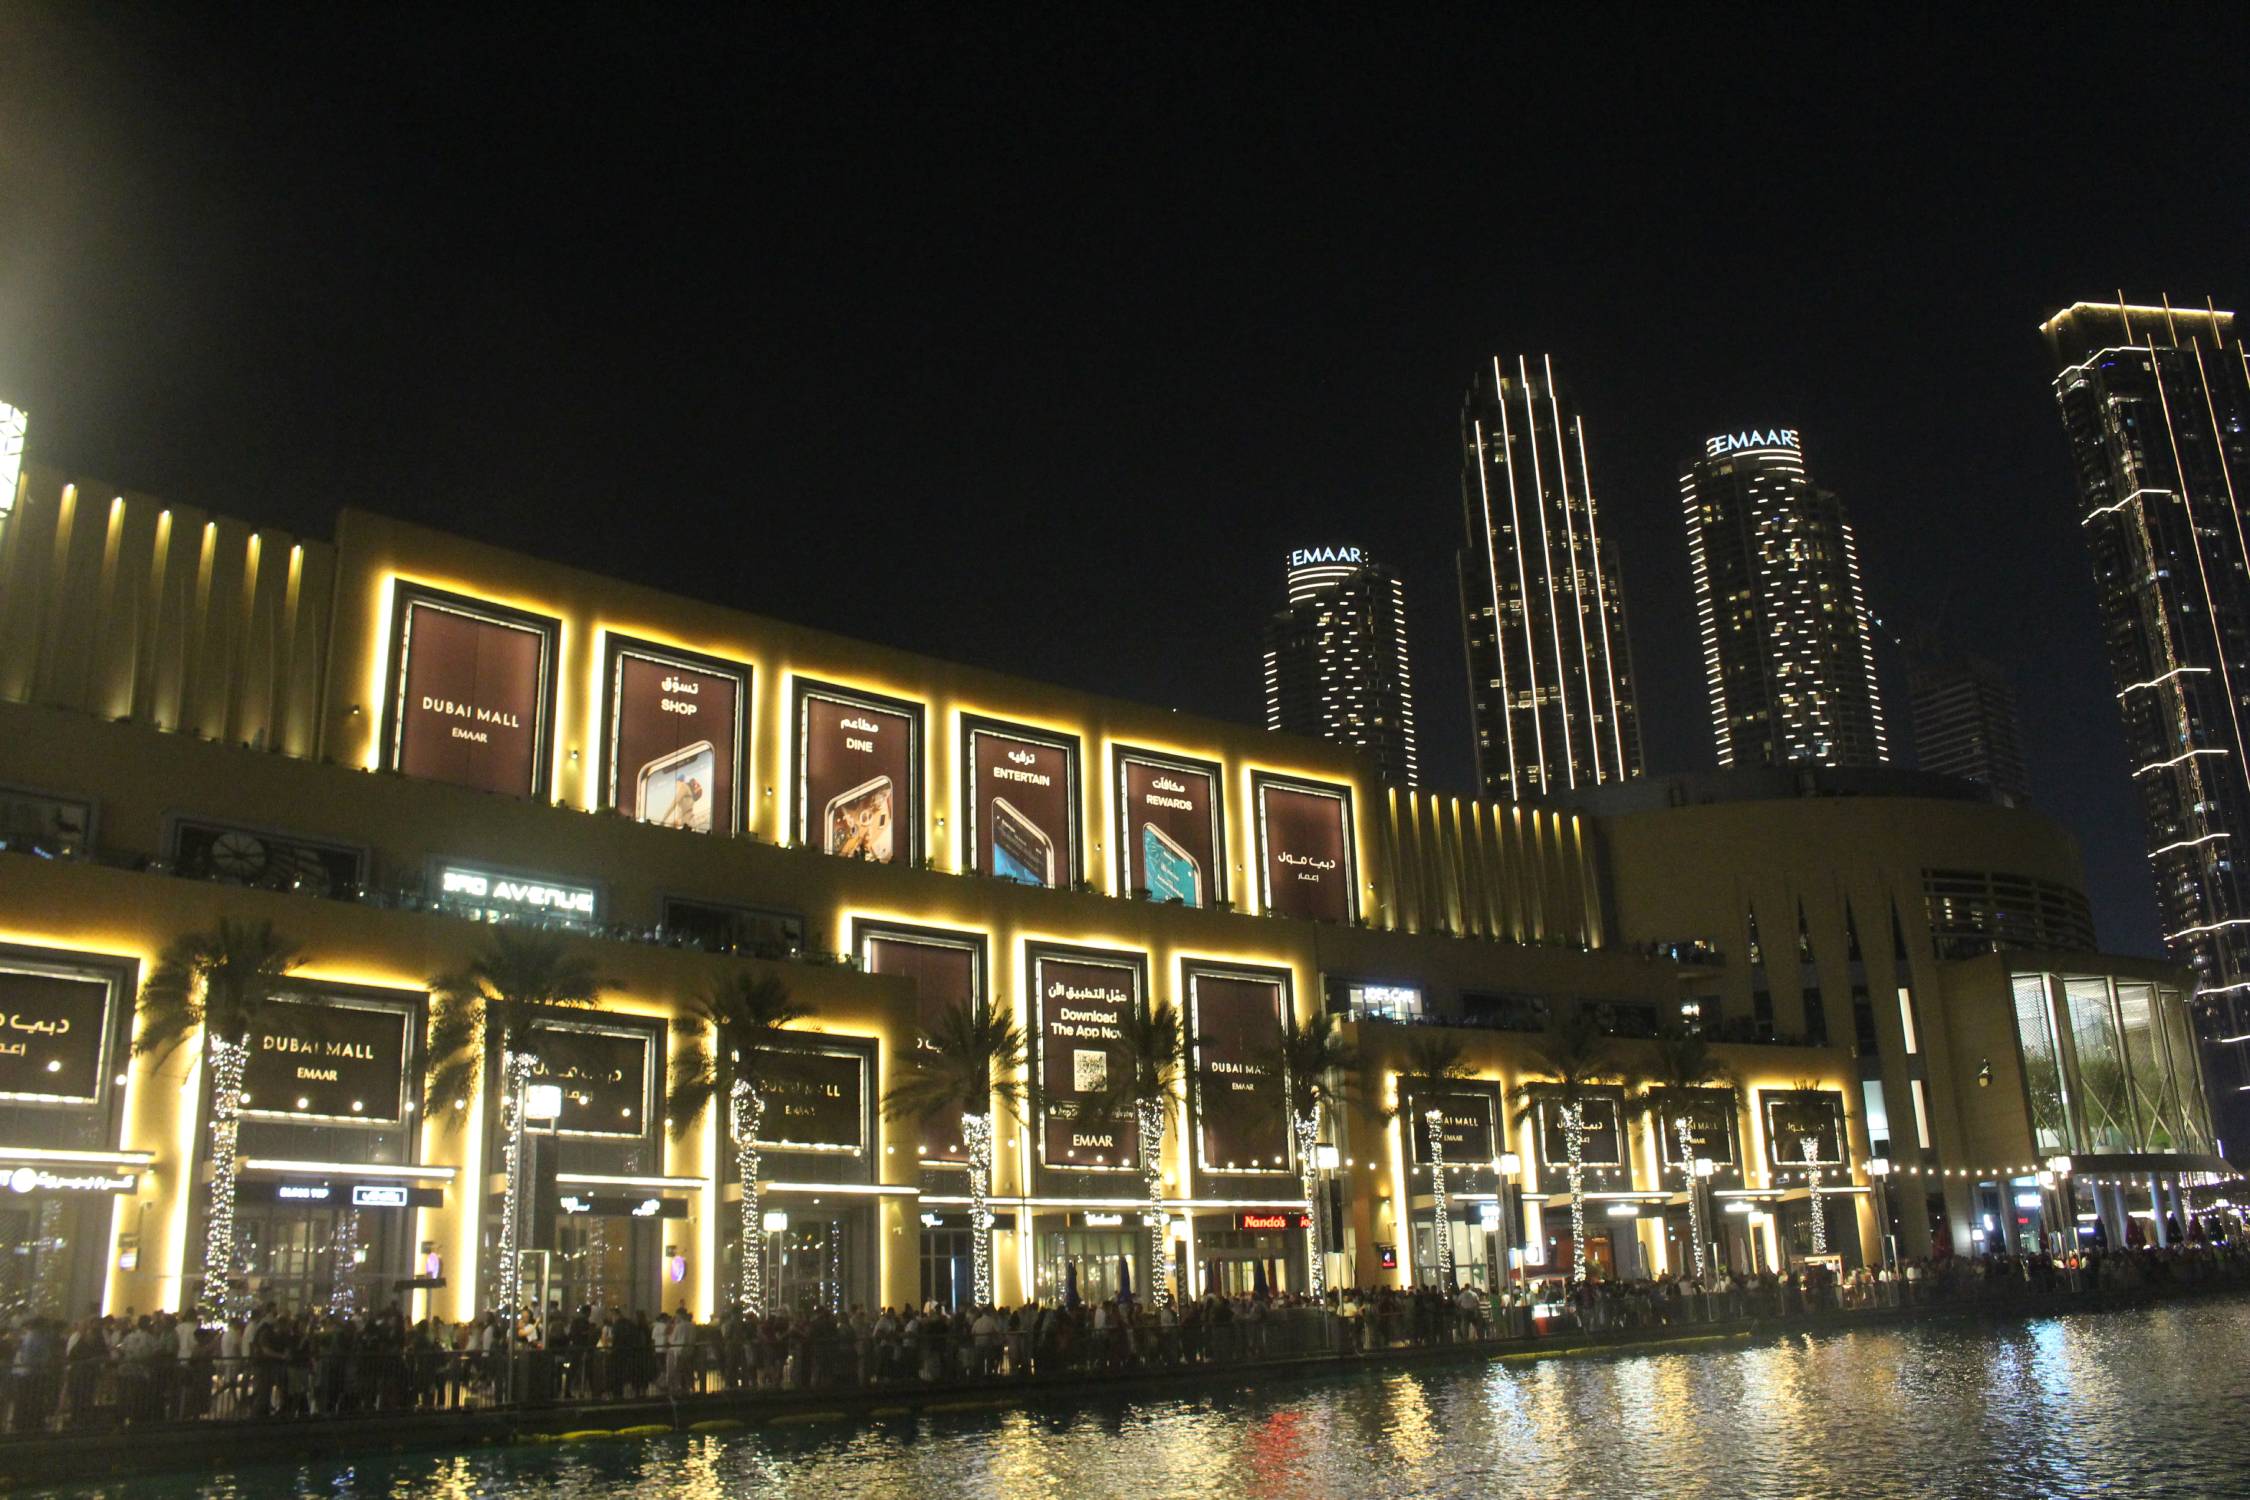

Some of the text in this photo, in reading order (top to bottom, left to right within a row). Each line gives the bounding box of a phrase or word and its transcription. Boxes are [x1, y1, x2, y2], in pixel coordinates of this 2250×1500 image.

[1714, 429, 1795, 454] EMAAR
[1292, 546, 1362, 567] EMAAR
[422, 696, 520, 728] DUBAI MALL
[661, 698, 698, 715] SHOP
[840, 717, 879, 733] مطاعم
[451, 727, 488, 743] EMAAR
[846, 737, 873, 753] DINE
[1008, 749, 1036, 765] ترفيه
[993, 766, 1050, 787] ENTERTAIN
[1146, 794, 1193, 812] REWARDS
[1277, 851, 1336, 870] دبي مول
[1065, 986, 1105, 1000] التطبيق
[1060, 1007, 1118, 1024] Download
[10, 1014, 70, 1036] دبي
[1051, 1023, 1074, 1035] The
[1075, 1024, 1101, 1039] App
[263, 1035, 375, 1060] DUBAI MALL
[296, 1067, 338, 1081] EMAAR
[1211, 1061, 1271, 1076] DUBAI MA
[1231, 1082, 1255, 1091] EMAAR
[1455, 1117, 1479, 1127] MALL
[1072, 1134, 1113, 1147] EMAAR
[1244, 1215, 1287, 1229] Nando's
